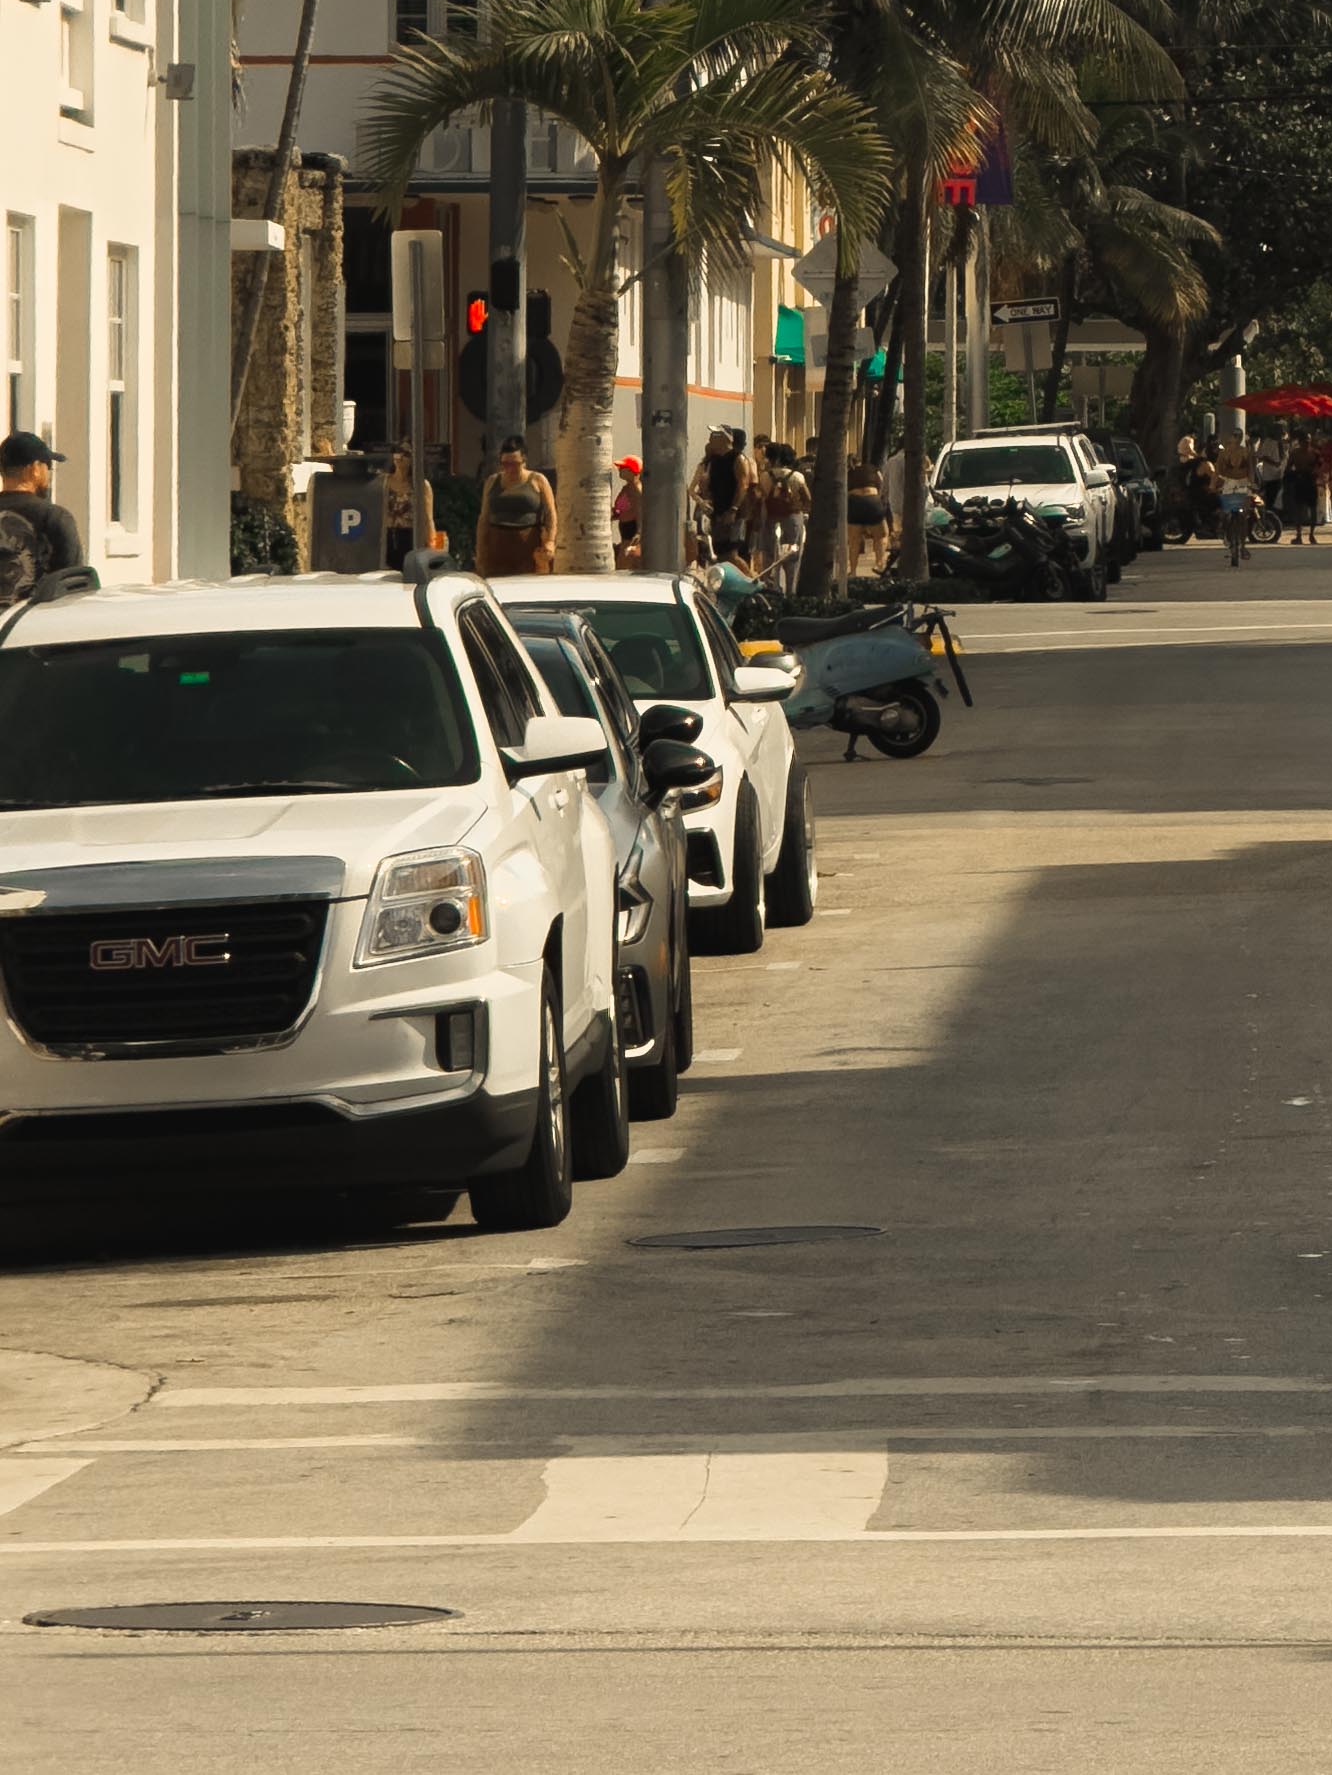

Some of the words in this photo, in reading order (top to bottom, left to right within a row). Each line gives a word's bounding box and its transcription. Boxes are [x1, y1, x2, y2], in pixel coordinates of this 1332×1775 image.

[1009, 308, 1029, 317] ONE
[1032, 306, 1053, 315] WAY
[341, 508, 362, 534] P
[88, 932, 231, 971] GMC
